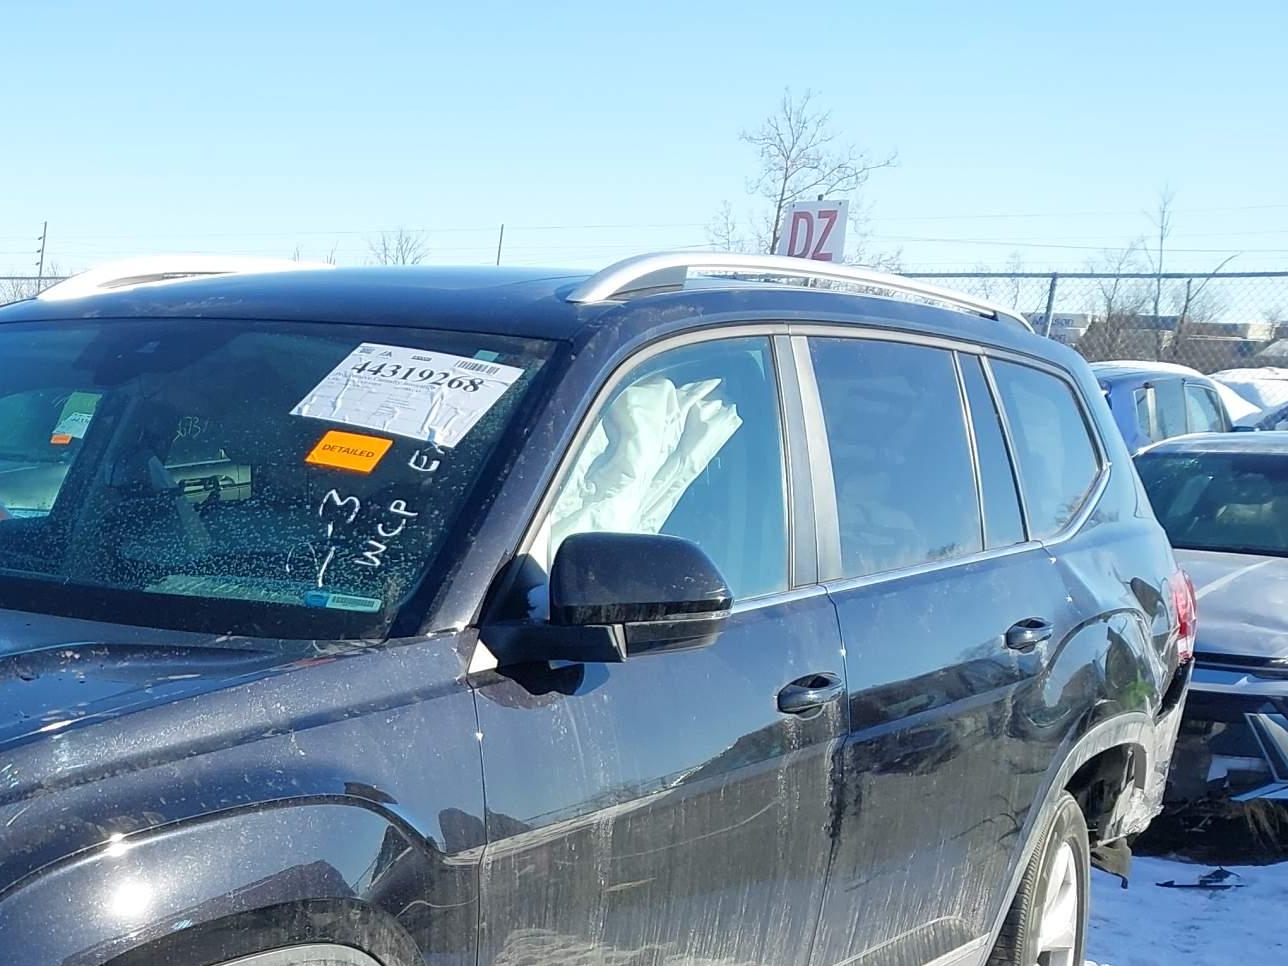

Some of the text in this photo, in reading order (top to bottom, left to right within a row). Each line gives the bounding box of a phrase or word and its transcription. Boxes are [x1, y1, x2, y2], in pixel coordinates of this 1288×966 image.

[787, 210, 838, 261] DZ
[351, 360, 485, 393] 44319268
[322, 444, 375, 458] DETAILED
